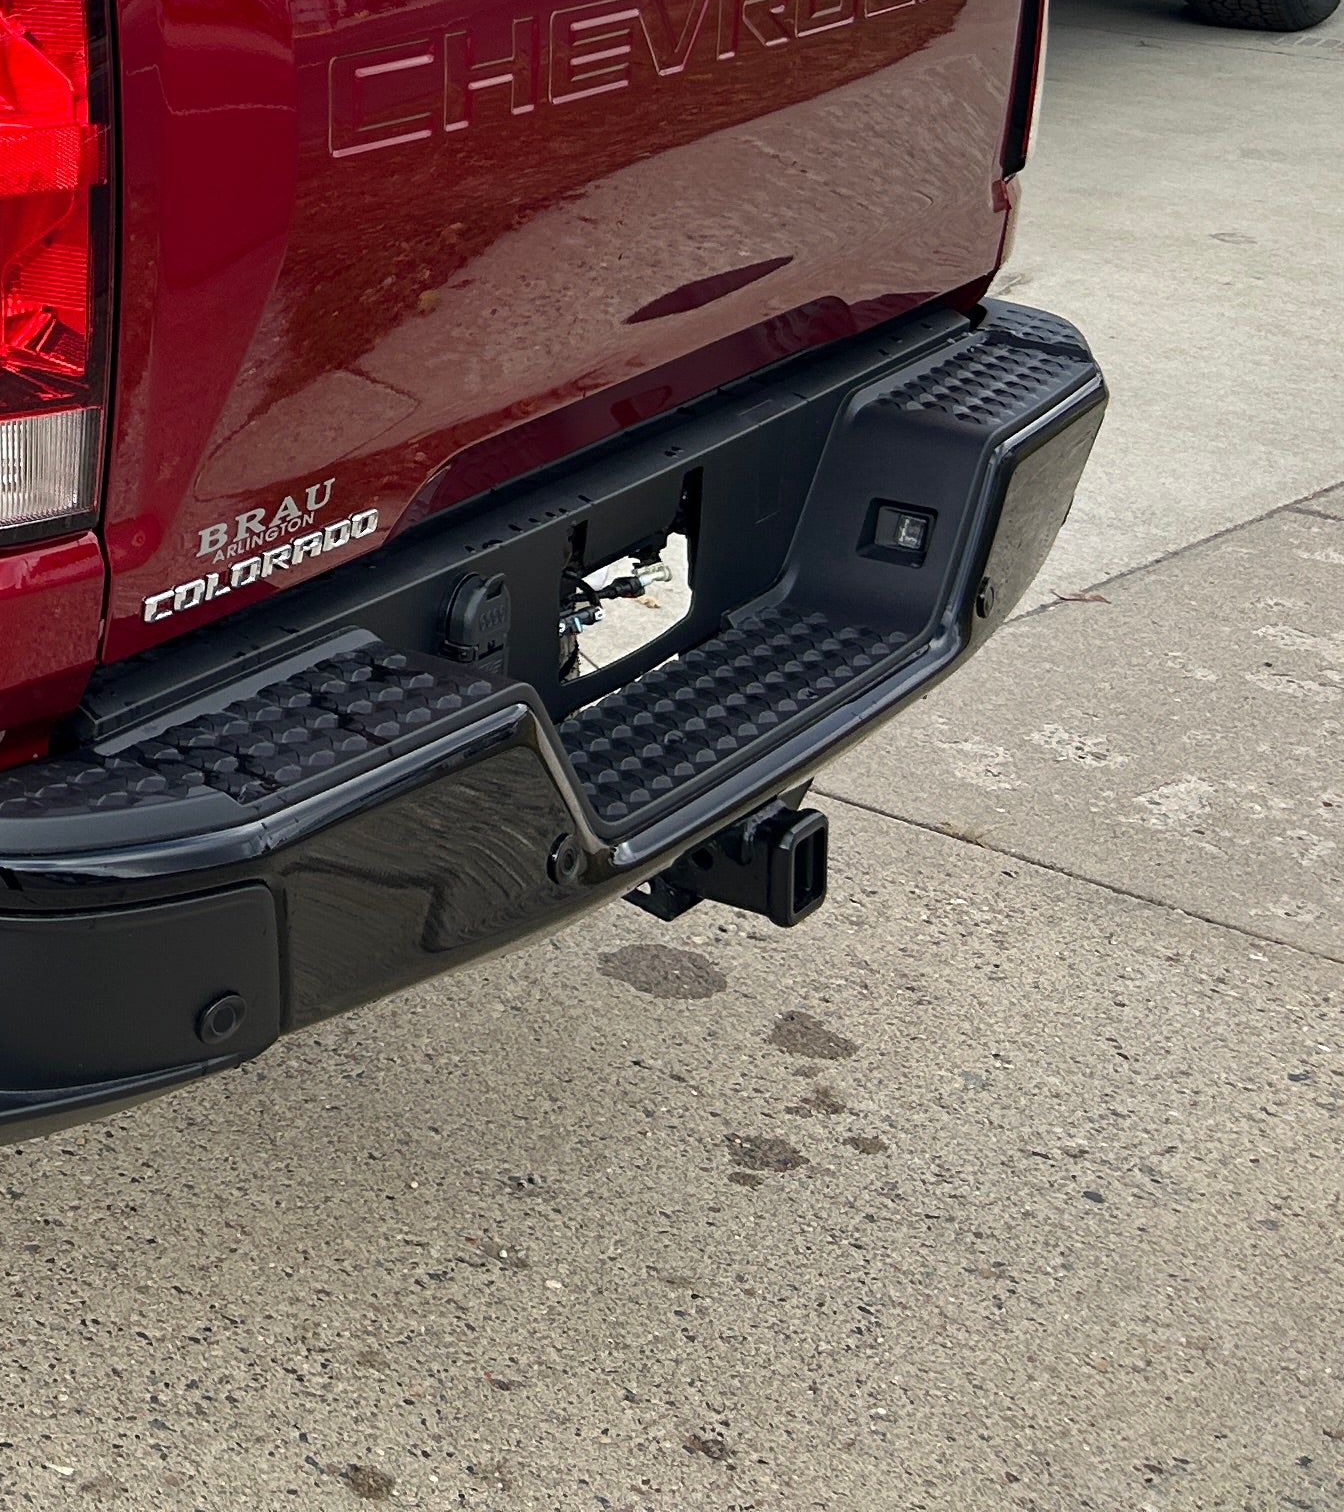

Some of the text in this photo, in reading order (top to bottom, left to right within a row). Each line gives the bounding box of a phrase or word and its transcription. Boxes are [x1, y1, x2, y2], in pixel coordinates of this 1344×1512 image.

[195, 477, 336, 558] BRAU
[212, 510, 315, 564] ARLINGTON
[142, 507, 380, 624] COLORADO
